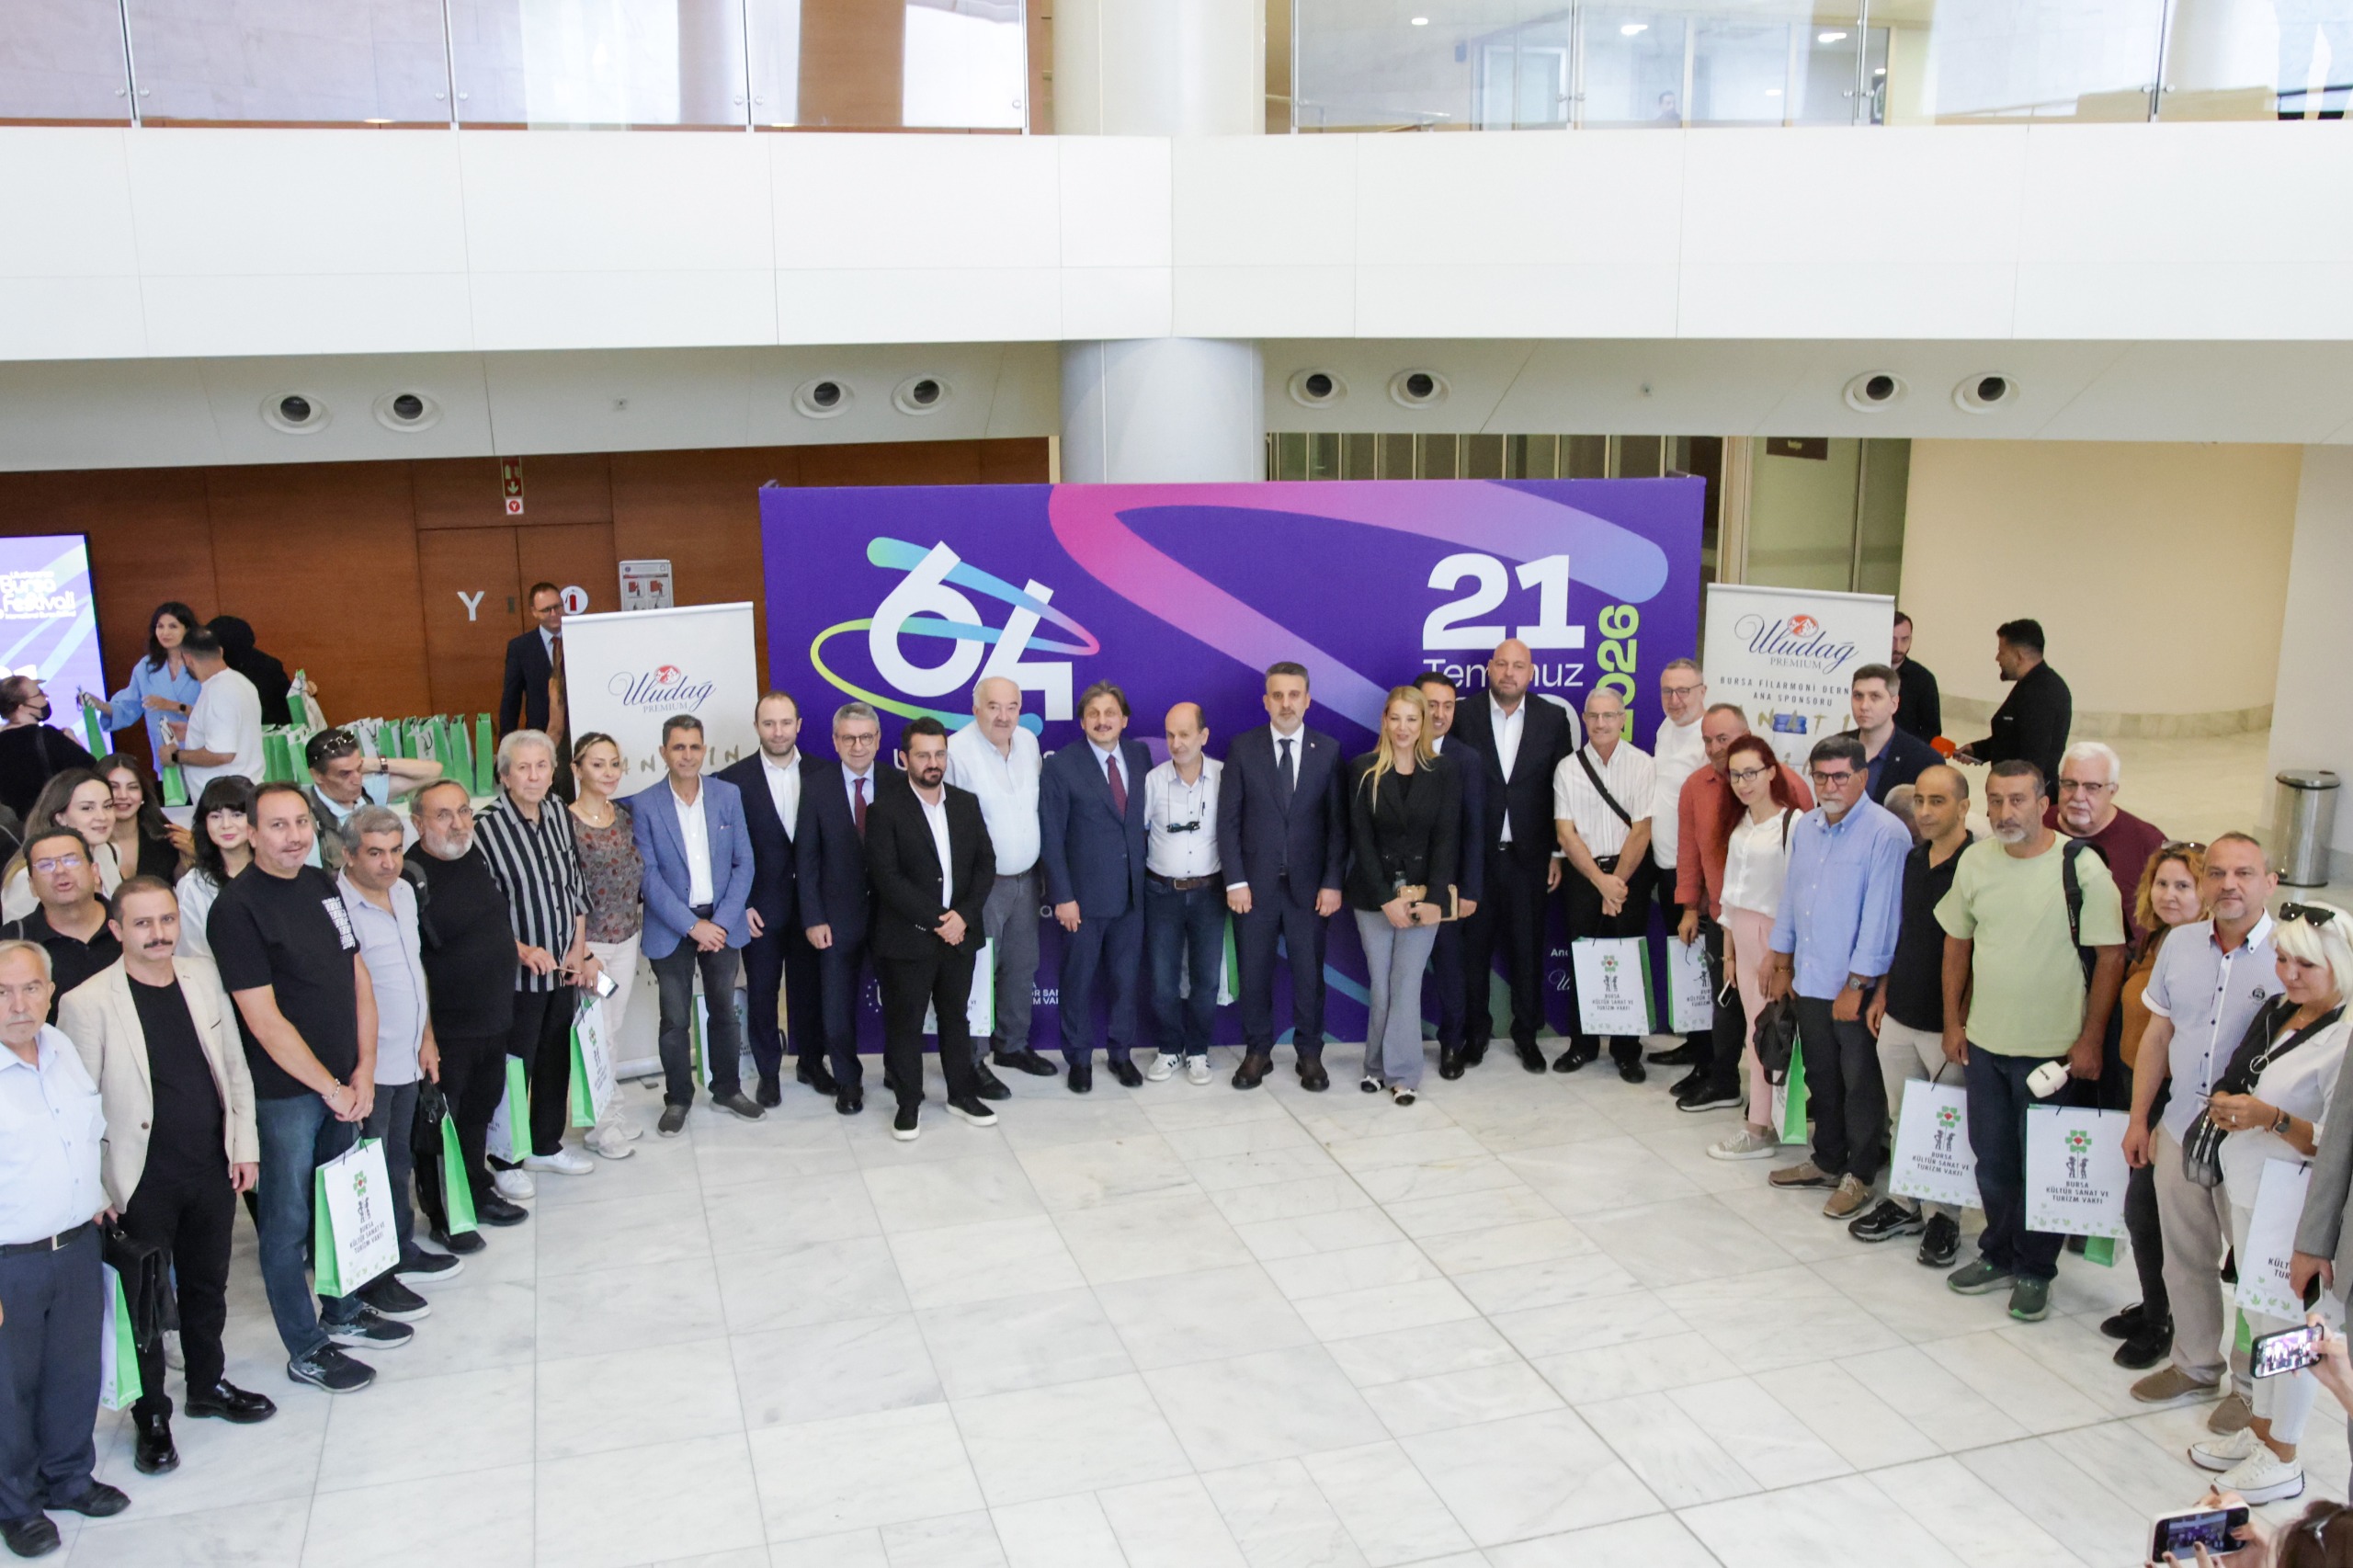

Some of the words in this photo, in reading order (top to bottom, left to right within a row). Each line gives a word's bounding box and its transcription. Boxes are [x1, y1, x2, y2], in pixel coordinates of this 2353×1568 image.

[457, 590, 485, 621] Y
[1422, 551, 1586, 650] 21
[869, 540, 1074, 722] 64
[1734, 613, 1859, 675] Uludağ
[1770, 656, 1822, 670] PREMIUM
[1423, 659, 1584, 688] Temuz
[1596, 604, 1640, 743] 026
[608, 671, 717, 712] Uludağ
[1720, 676, 1753, 687] BURSA
[1758, 678, 1817, 692] FİLARMONİ
[642, 701, 688, 713] PREMIUM
[1753, 692, 1771, 701] ANA
[1778, 694, 1834, 707] SPONSORU
[1912, 1154, 1937, 1165] KÜLTÜR
[1938, 1160, 1960, 1169] SANAT
[1931, 1152, 1952, 1160] BURSA
[1944, 1168, 1963, 1176] VAKFI
[2046, 1186, 2073, 1195] KÜLTÜR
[2065, 1180, 2089, 1188] BURSA
[2268, 1256, 2290, 1269] KÜLT
[2274, 1268, 2290, 1279] TUR
